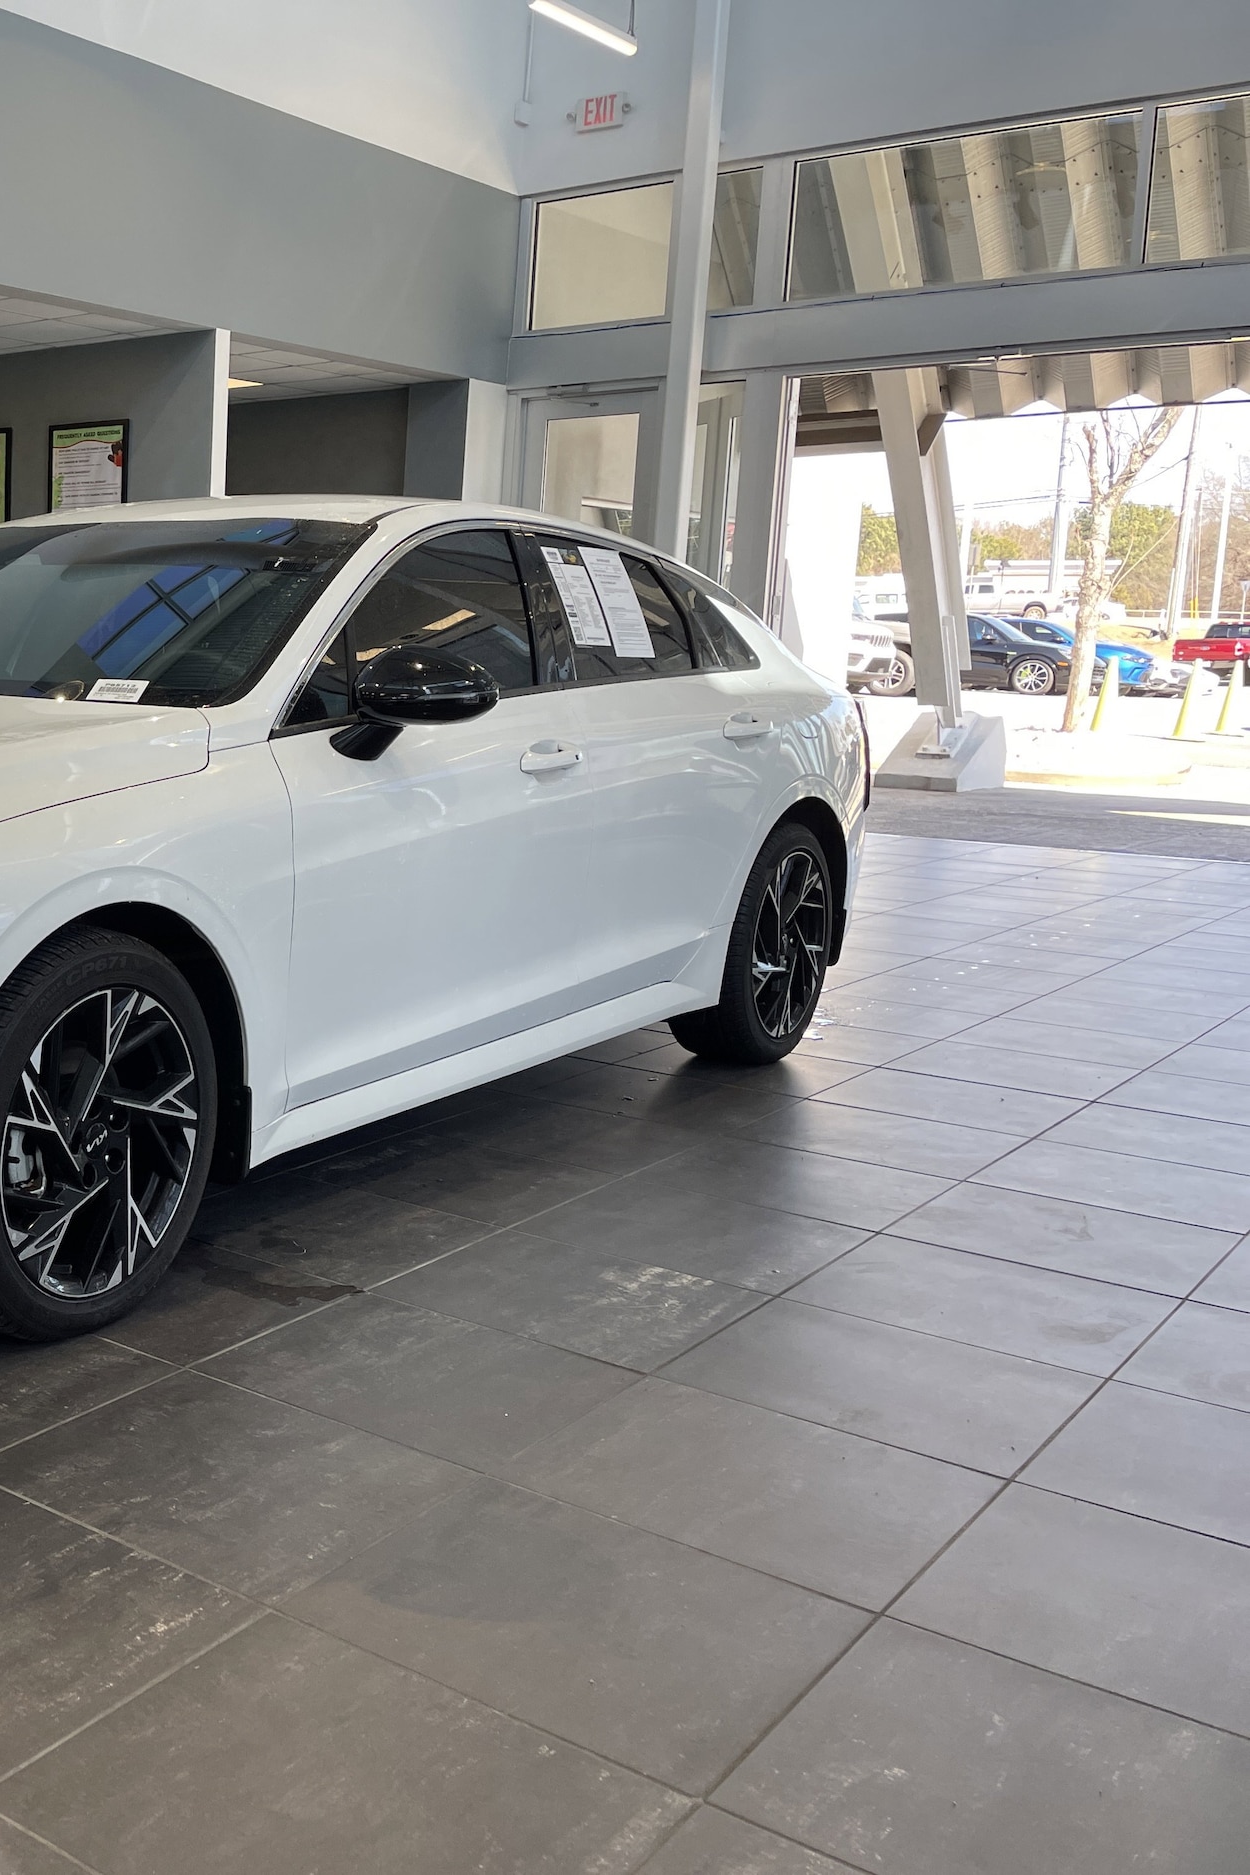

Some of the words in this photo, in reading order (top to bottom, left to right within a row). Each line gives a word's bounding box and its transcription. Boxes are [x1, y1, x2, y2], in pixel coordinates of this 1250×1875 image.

[584, 94, 617, 126] EXIT
[66, 956, 127, 986] CP671
[86, 1129, 108, 1153] KIA
